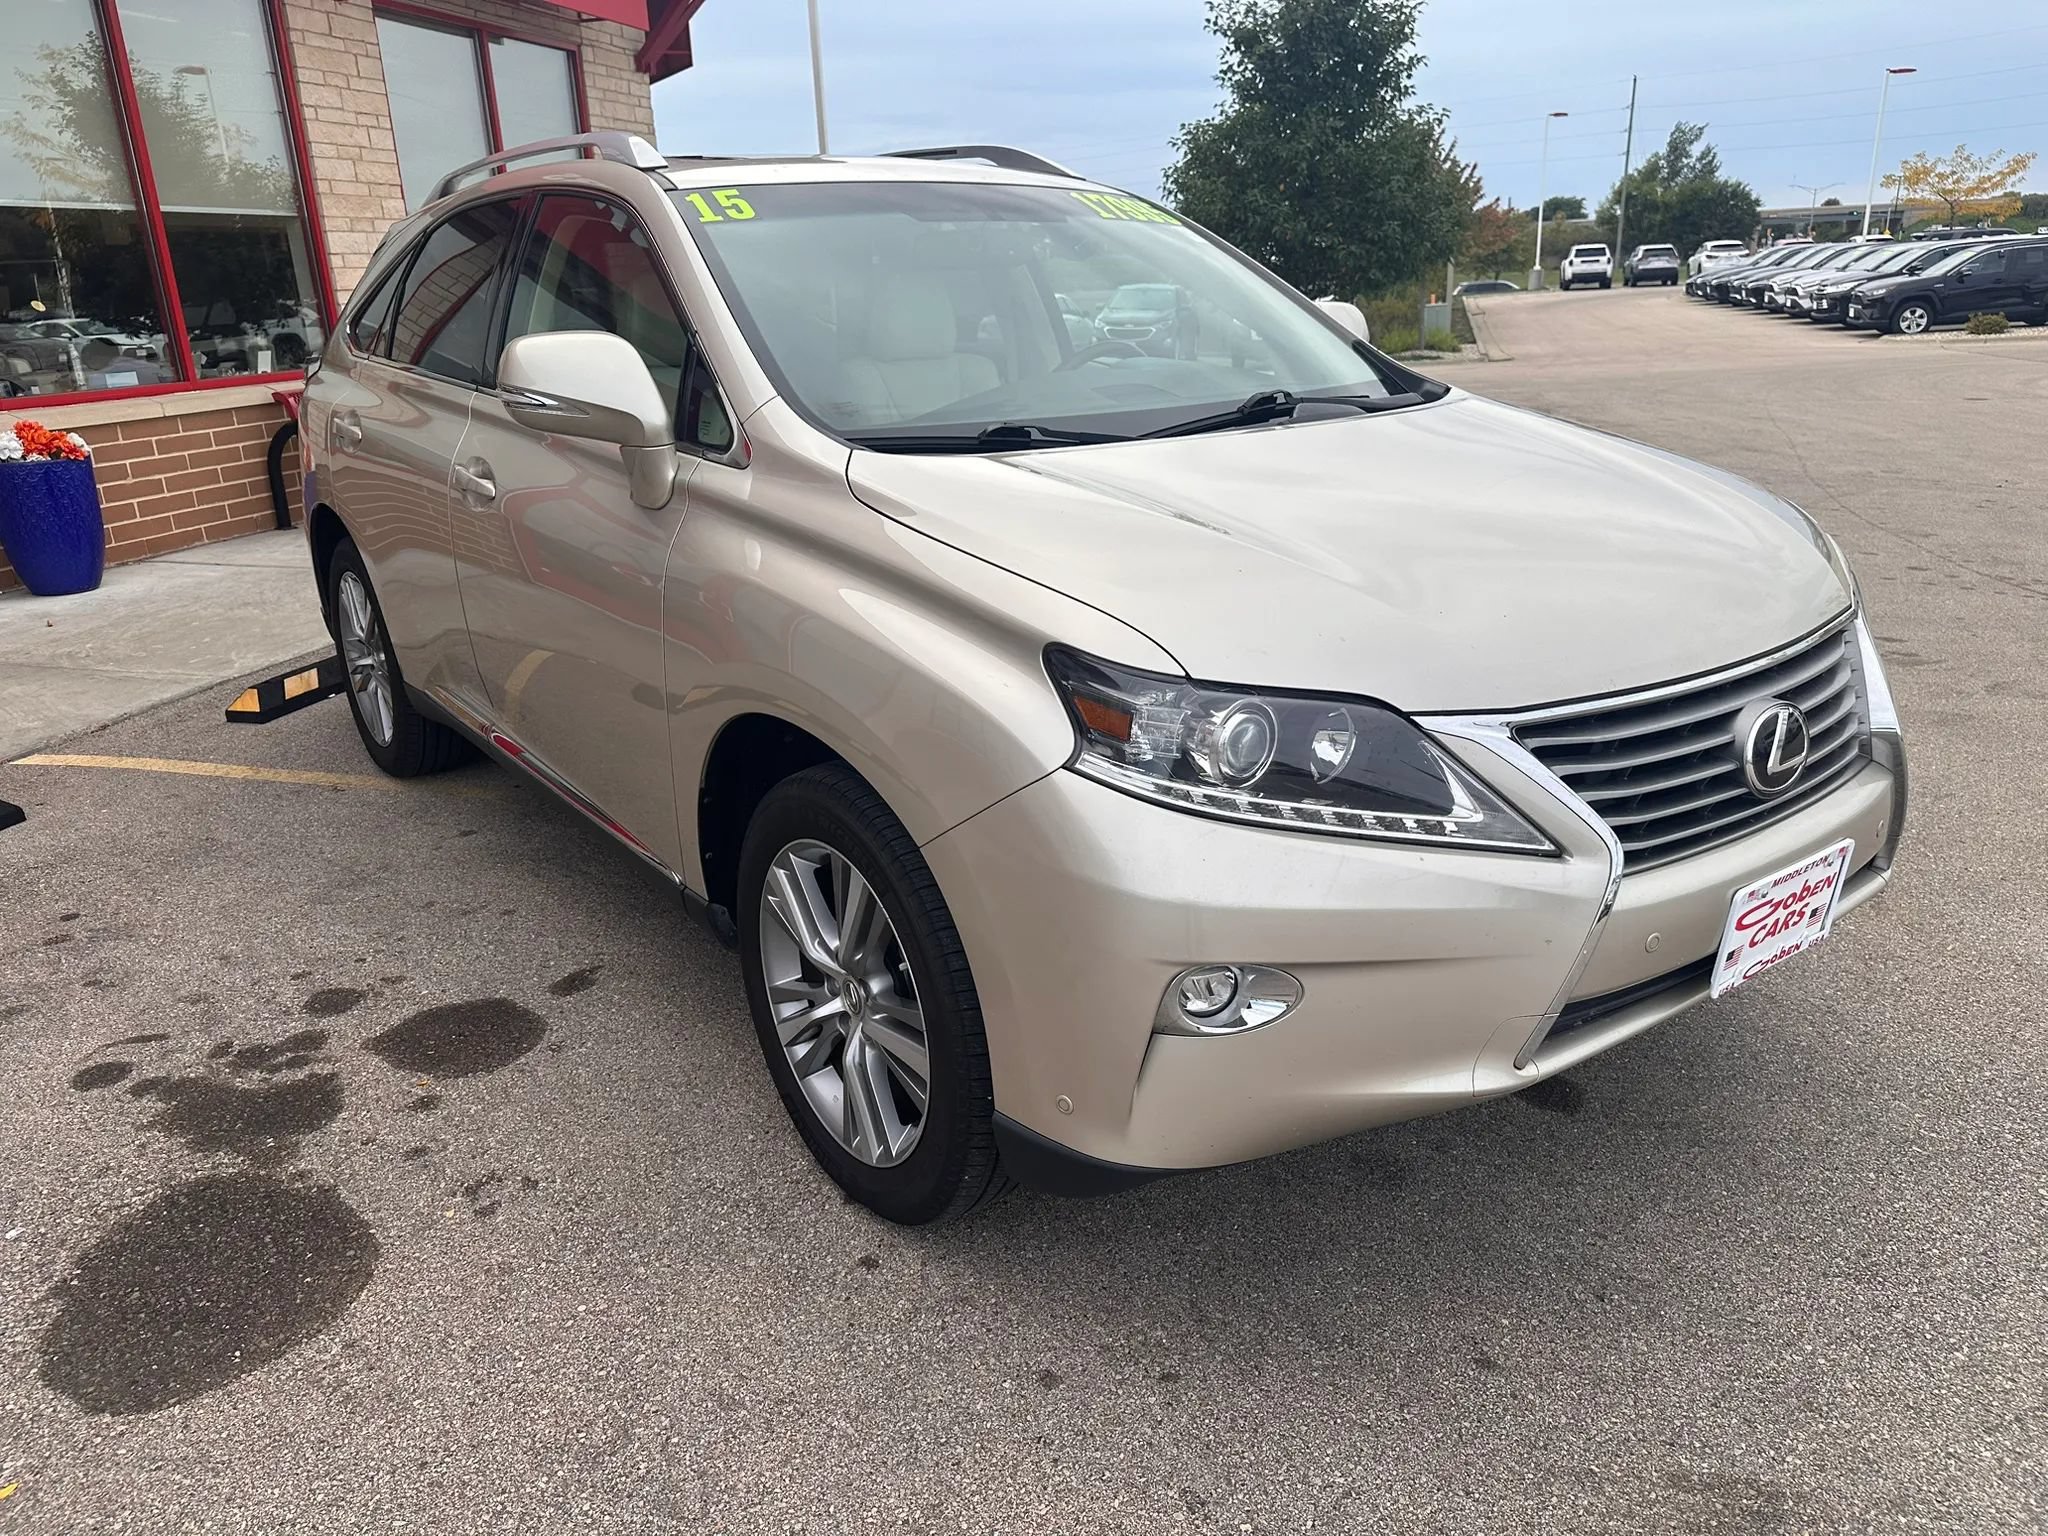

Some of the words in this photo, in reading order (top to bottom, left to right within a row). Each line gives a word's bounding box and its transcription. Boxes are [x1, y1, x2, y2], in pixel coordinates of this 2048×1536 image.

[685, 188, 756, 223] 15
[1770, 853, 1831, 889] MIDDLETON
[1748, 901, 1810, 949] CARS
